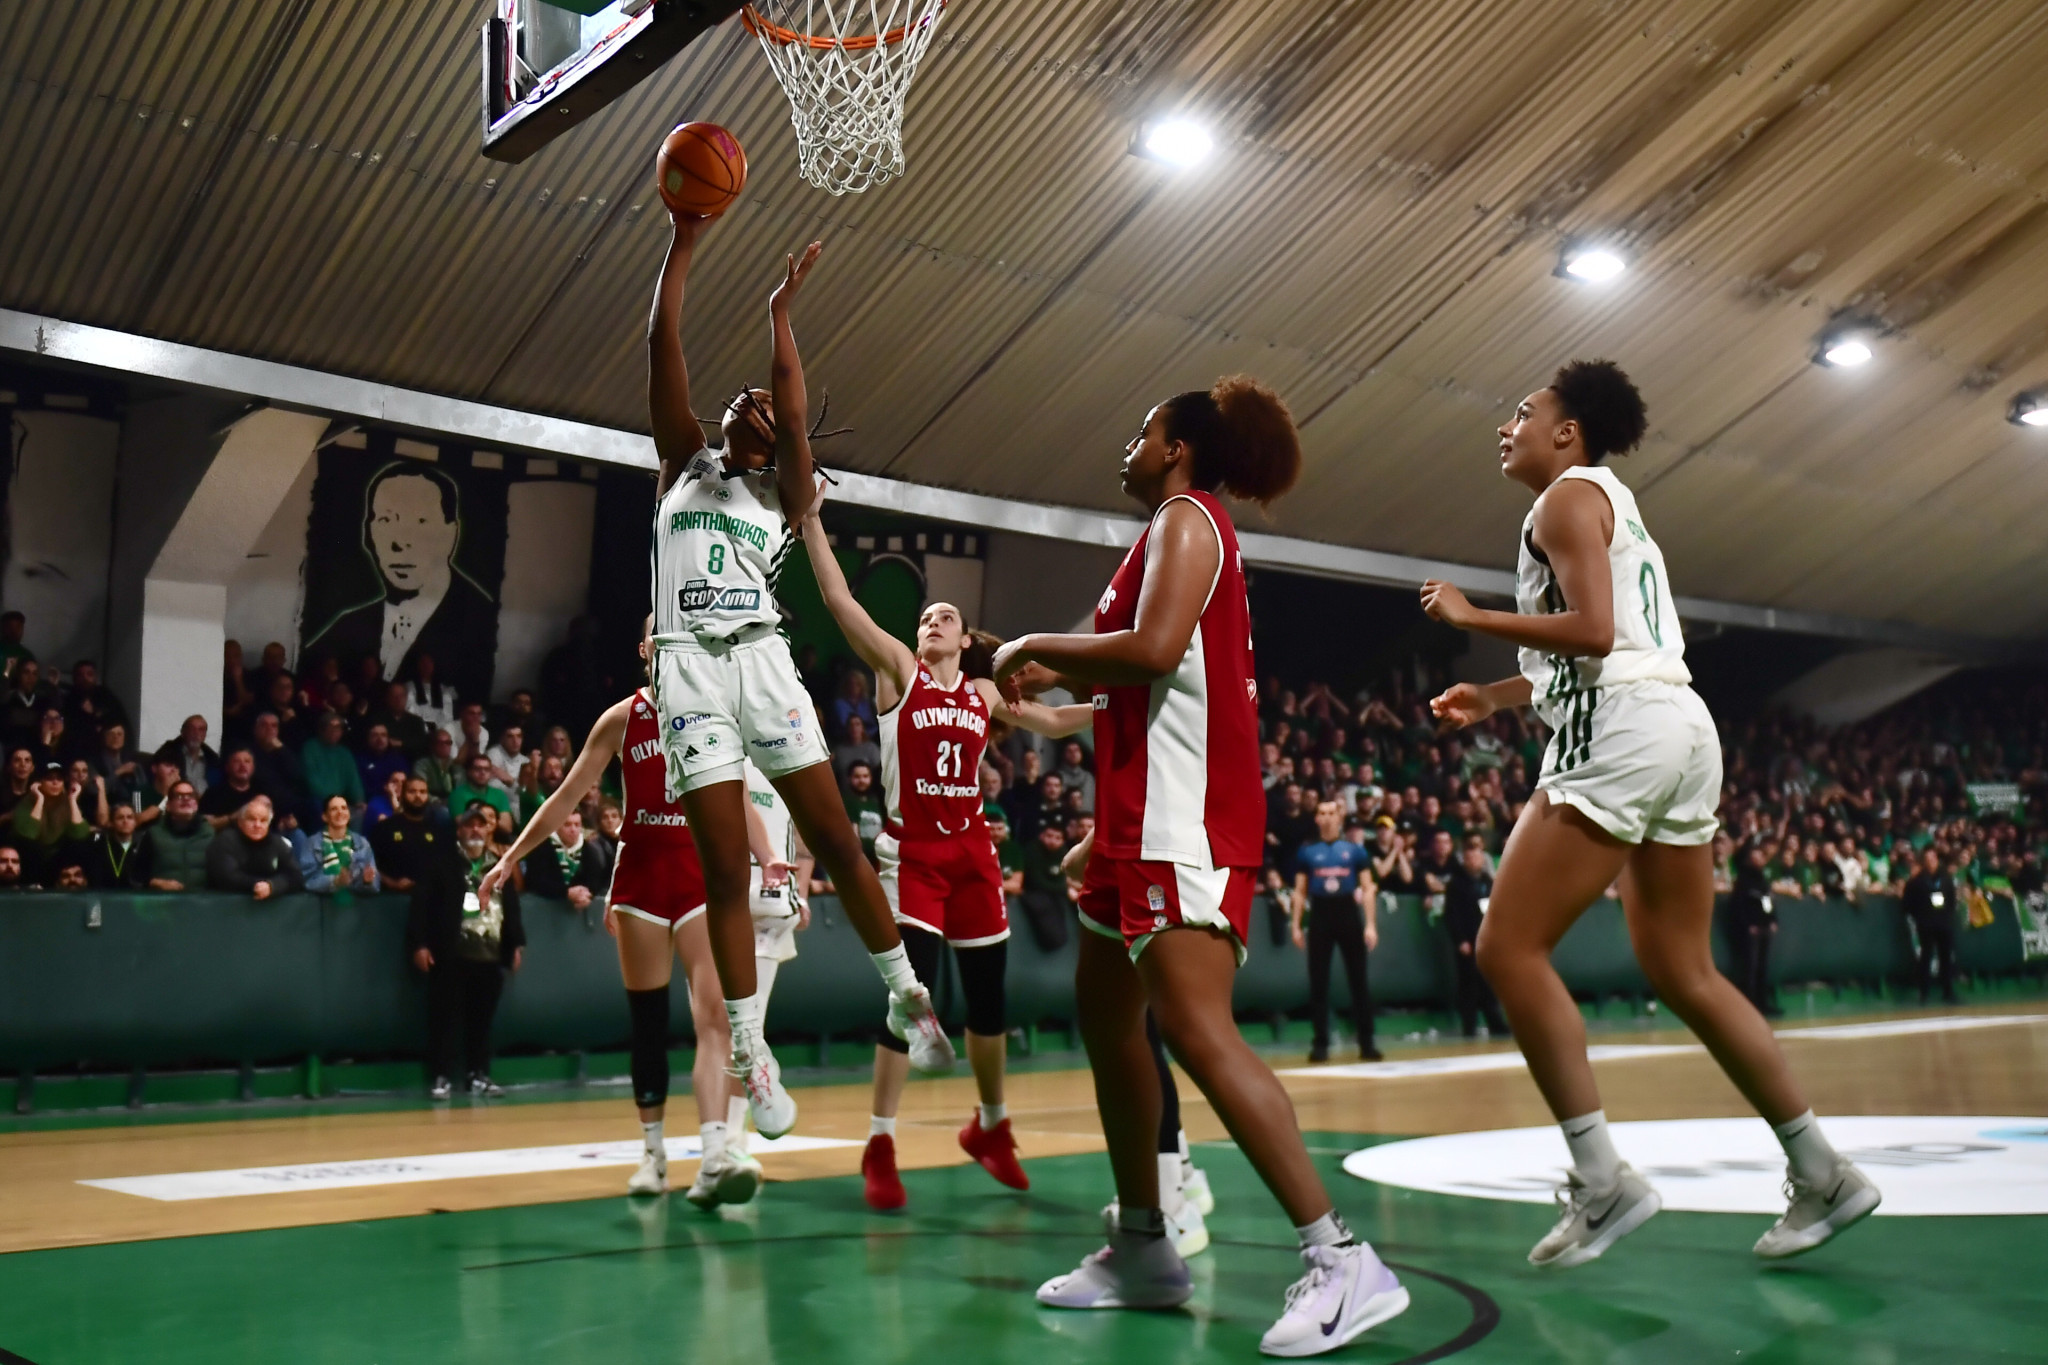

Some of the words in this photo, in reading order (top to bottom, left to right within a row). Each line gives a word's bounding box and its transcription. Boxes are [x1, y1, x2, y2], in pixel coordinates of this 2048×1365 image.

[671, 511, 769, 552] PANATHINAIKOS
[707, 543, 726, 575] 8
[912, 707, 987, 738] OLYMPIACOS
[936, 740, 962, 778] 21
